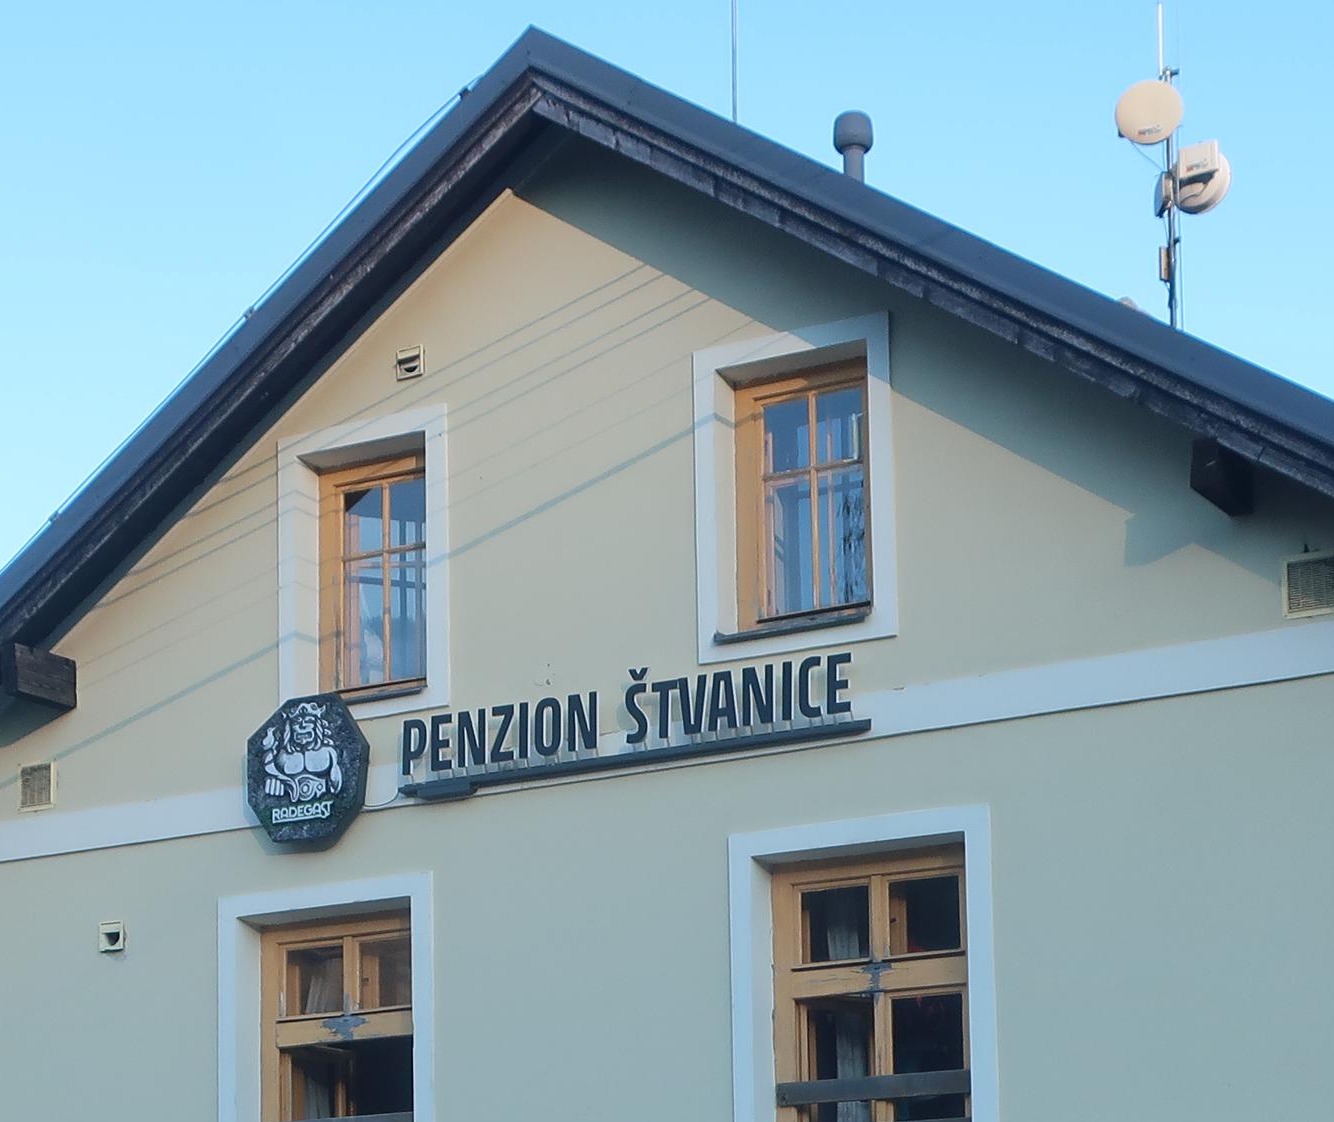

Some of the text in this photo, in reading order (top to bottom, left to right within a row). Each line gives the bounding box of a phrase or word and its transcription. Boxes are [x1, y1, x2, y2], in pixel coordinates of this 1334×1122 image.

[402, 652, 853, 776] PENZION ŠTVANICE
[272, 801, 335, 824] RADEGAST
